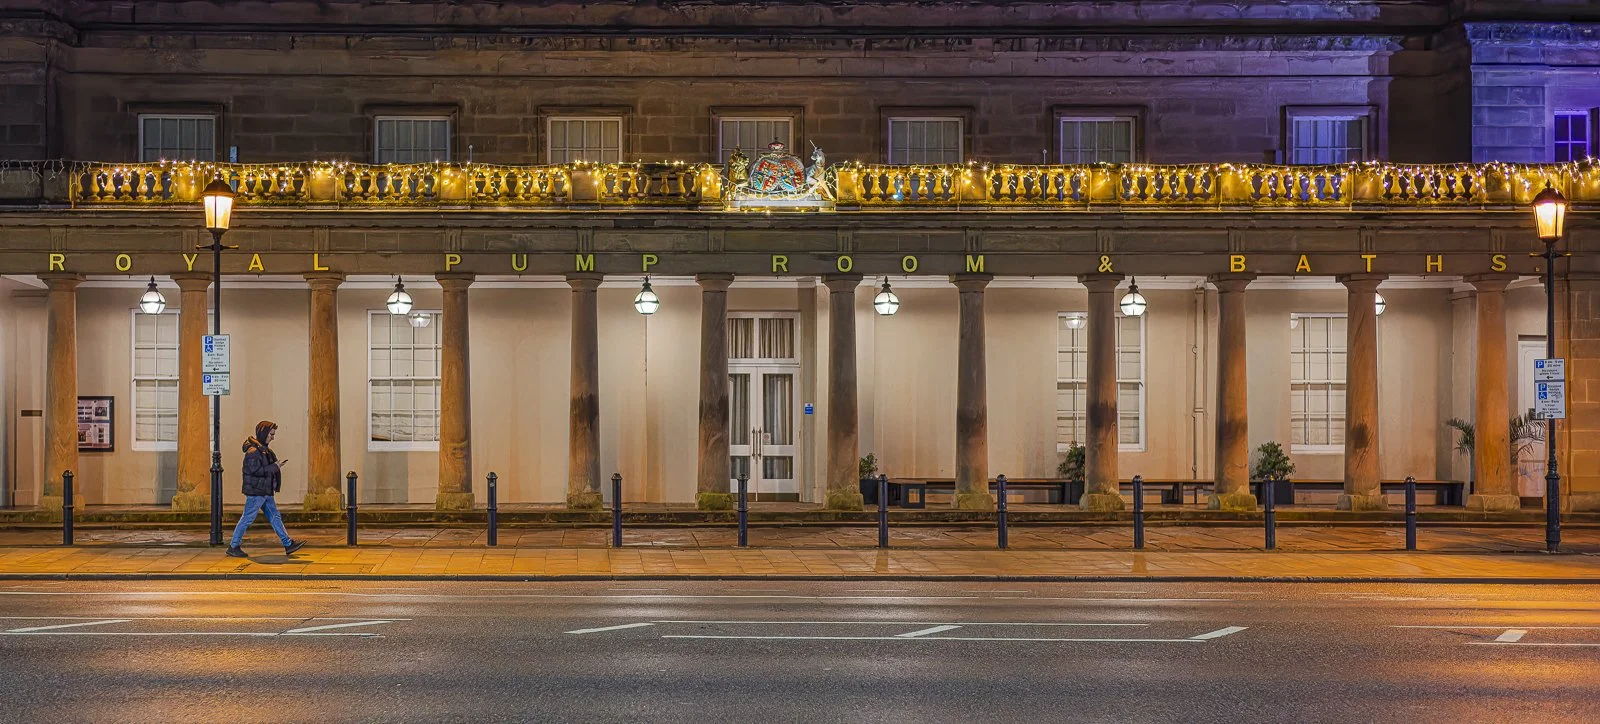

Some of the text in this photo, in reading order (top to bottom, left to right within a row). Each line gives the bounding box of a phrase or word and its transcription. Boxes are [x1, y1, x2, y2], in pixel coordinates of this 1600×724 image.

[49, 253, 329, 272] ROYAL
[445, 253, 660, 272] PUMP
[773, 254, 985, 273] ROOM
[1099, 254, 1113, 273] &
